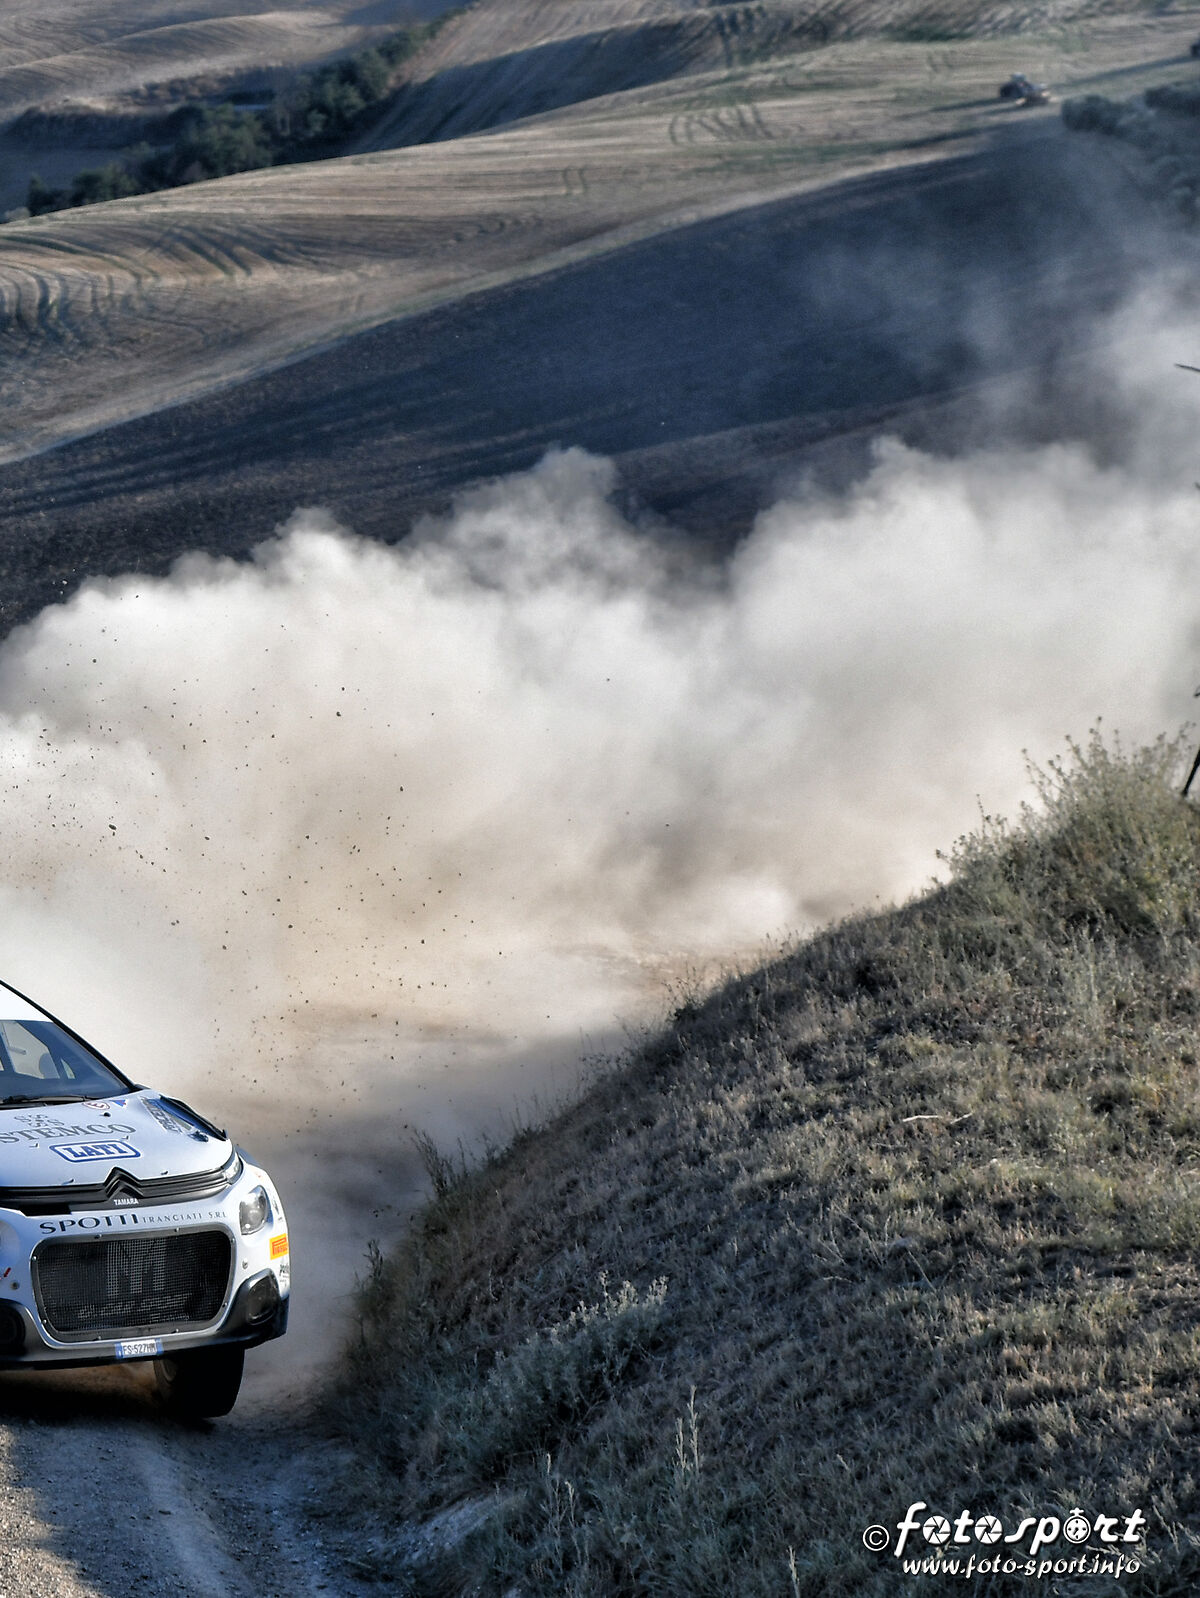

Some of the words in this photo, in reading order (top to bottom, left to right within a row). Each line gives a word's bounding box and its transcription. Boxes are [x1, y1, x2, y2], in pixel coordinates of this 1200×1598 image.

[63, 1143, 129, 1158] LATI
[113, 1198, 139, 1206] TAMARA
[39, 1213, 140, 1235] SPOTTI
